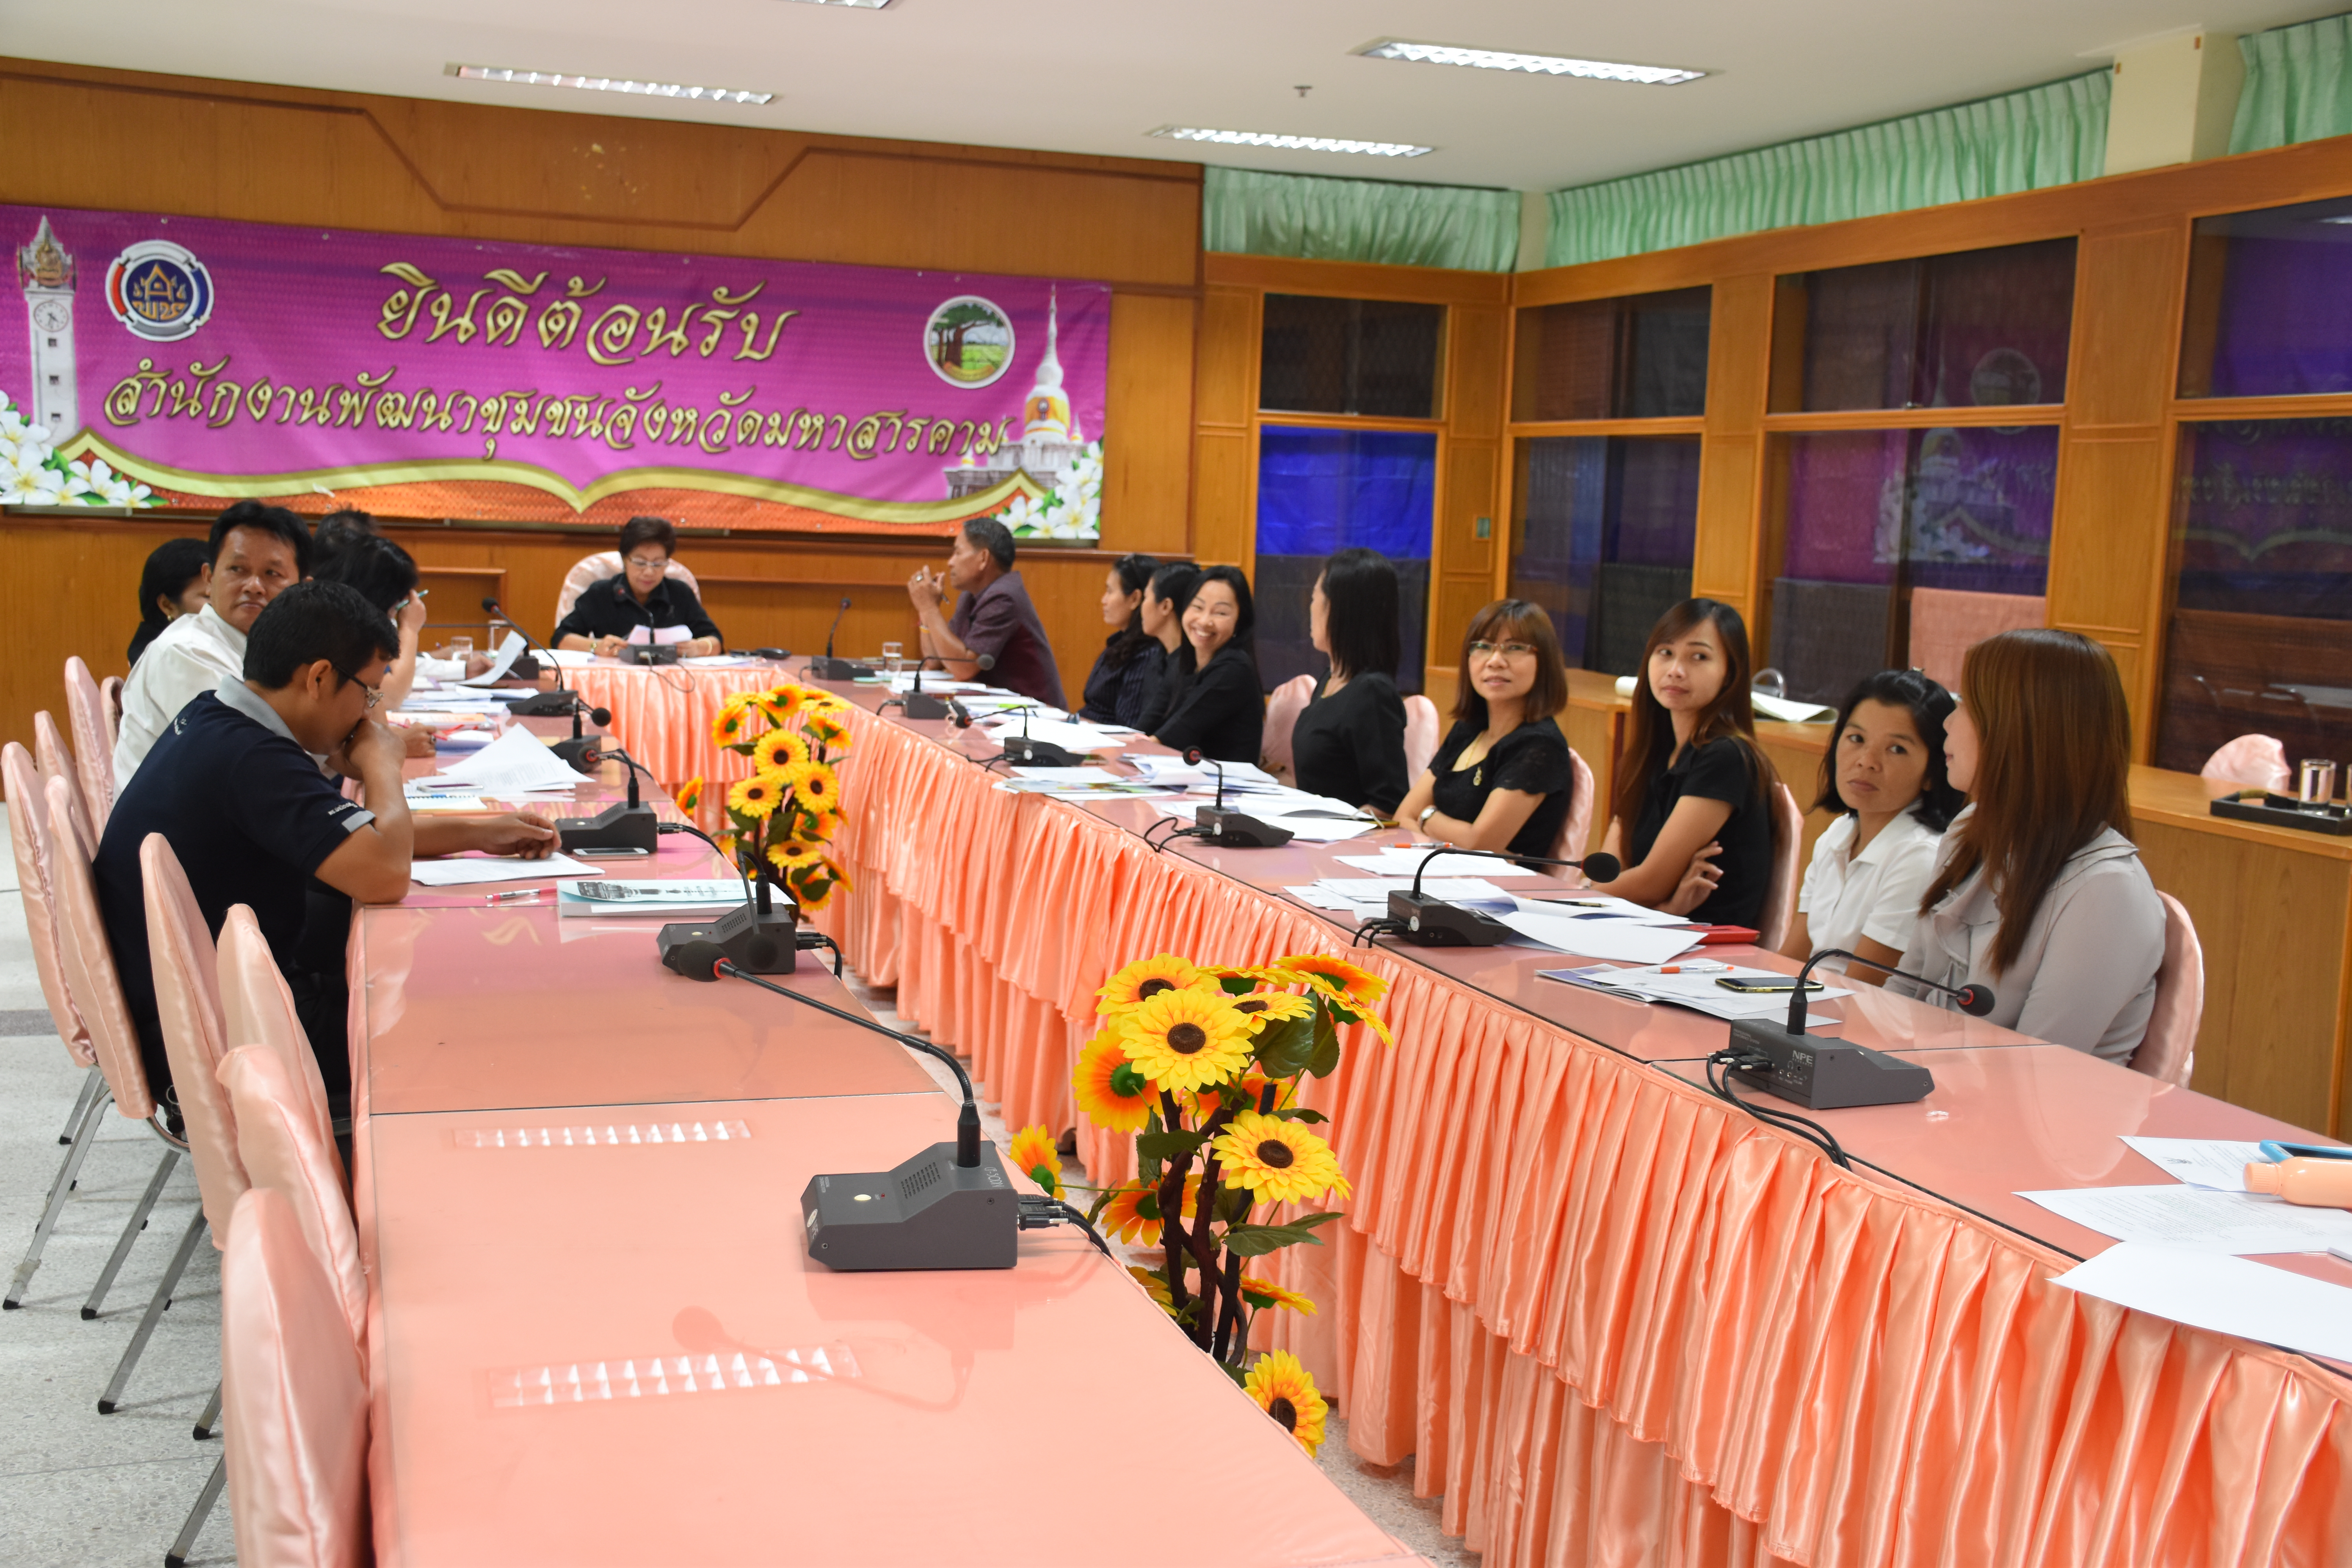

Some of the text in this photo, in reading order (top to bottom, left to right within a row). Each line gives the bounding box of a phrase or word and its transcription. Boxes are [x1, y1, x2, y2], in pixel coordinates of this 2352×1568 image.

[377, 261, 800, 366] ยินดีต้อนรับ
[104, 355, 1018, 461] สำนักงานพัฒนาชุมชนจังหวัดมหาสารคาม
[1792, 1050, 1813, 1065] NPE
